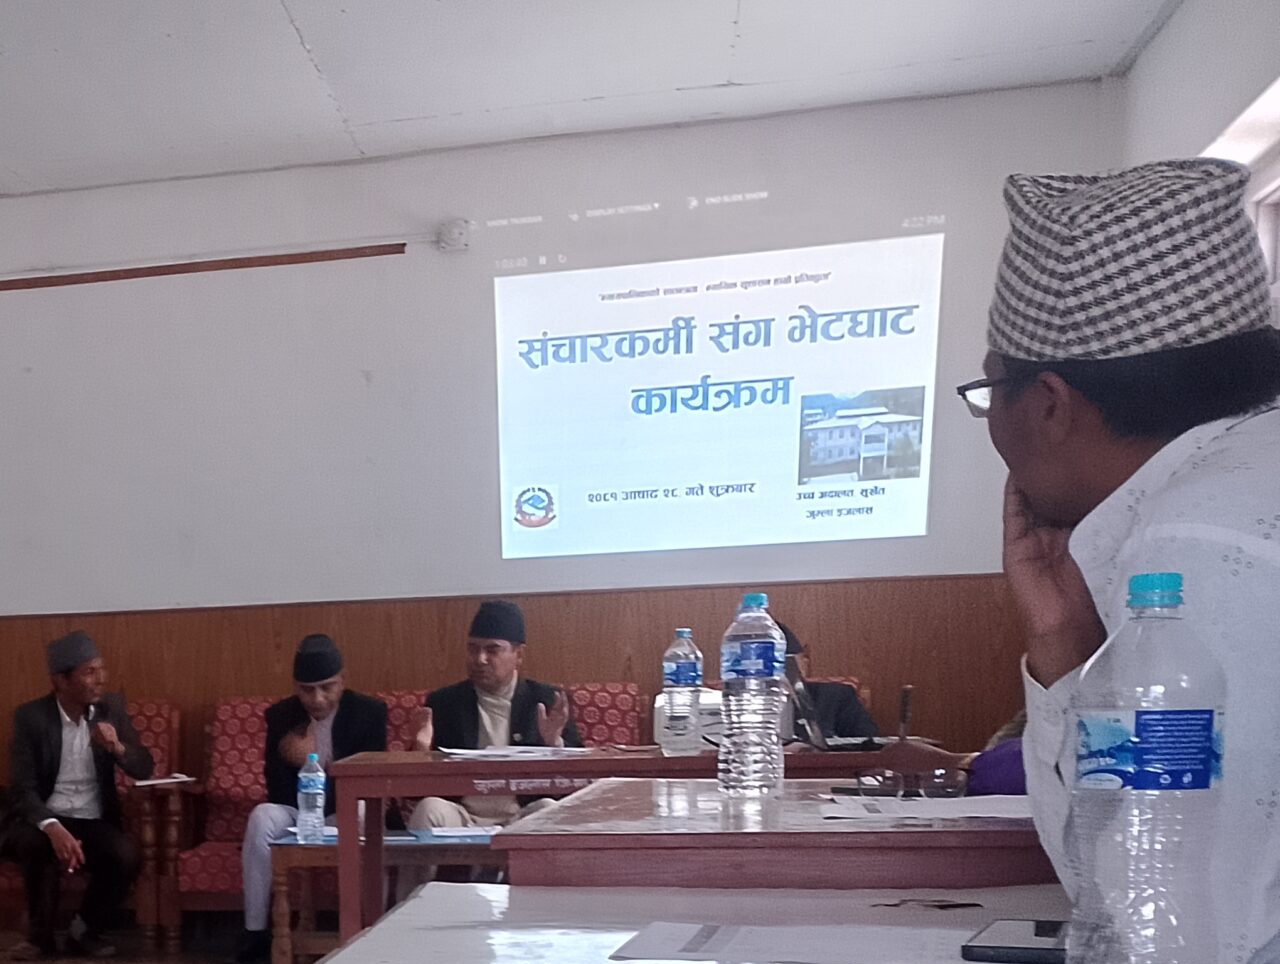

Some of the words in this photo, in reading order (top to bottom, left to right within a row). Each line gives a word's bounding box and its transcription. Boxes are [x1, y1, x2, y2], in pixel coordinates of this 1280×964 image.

[518, 316, 696, 369] संचारकर्मी
[708, 314, 775, 354] संग
[788, 304, 920, 344] भेटघाट
[631, 375, 794, 416] कार्यक्रम
[685, 483, 704, 497] गते
